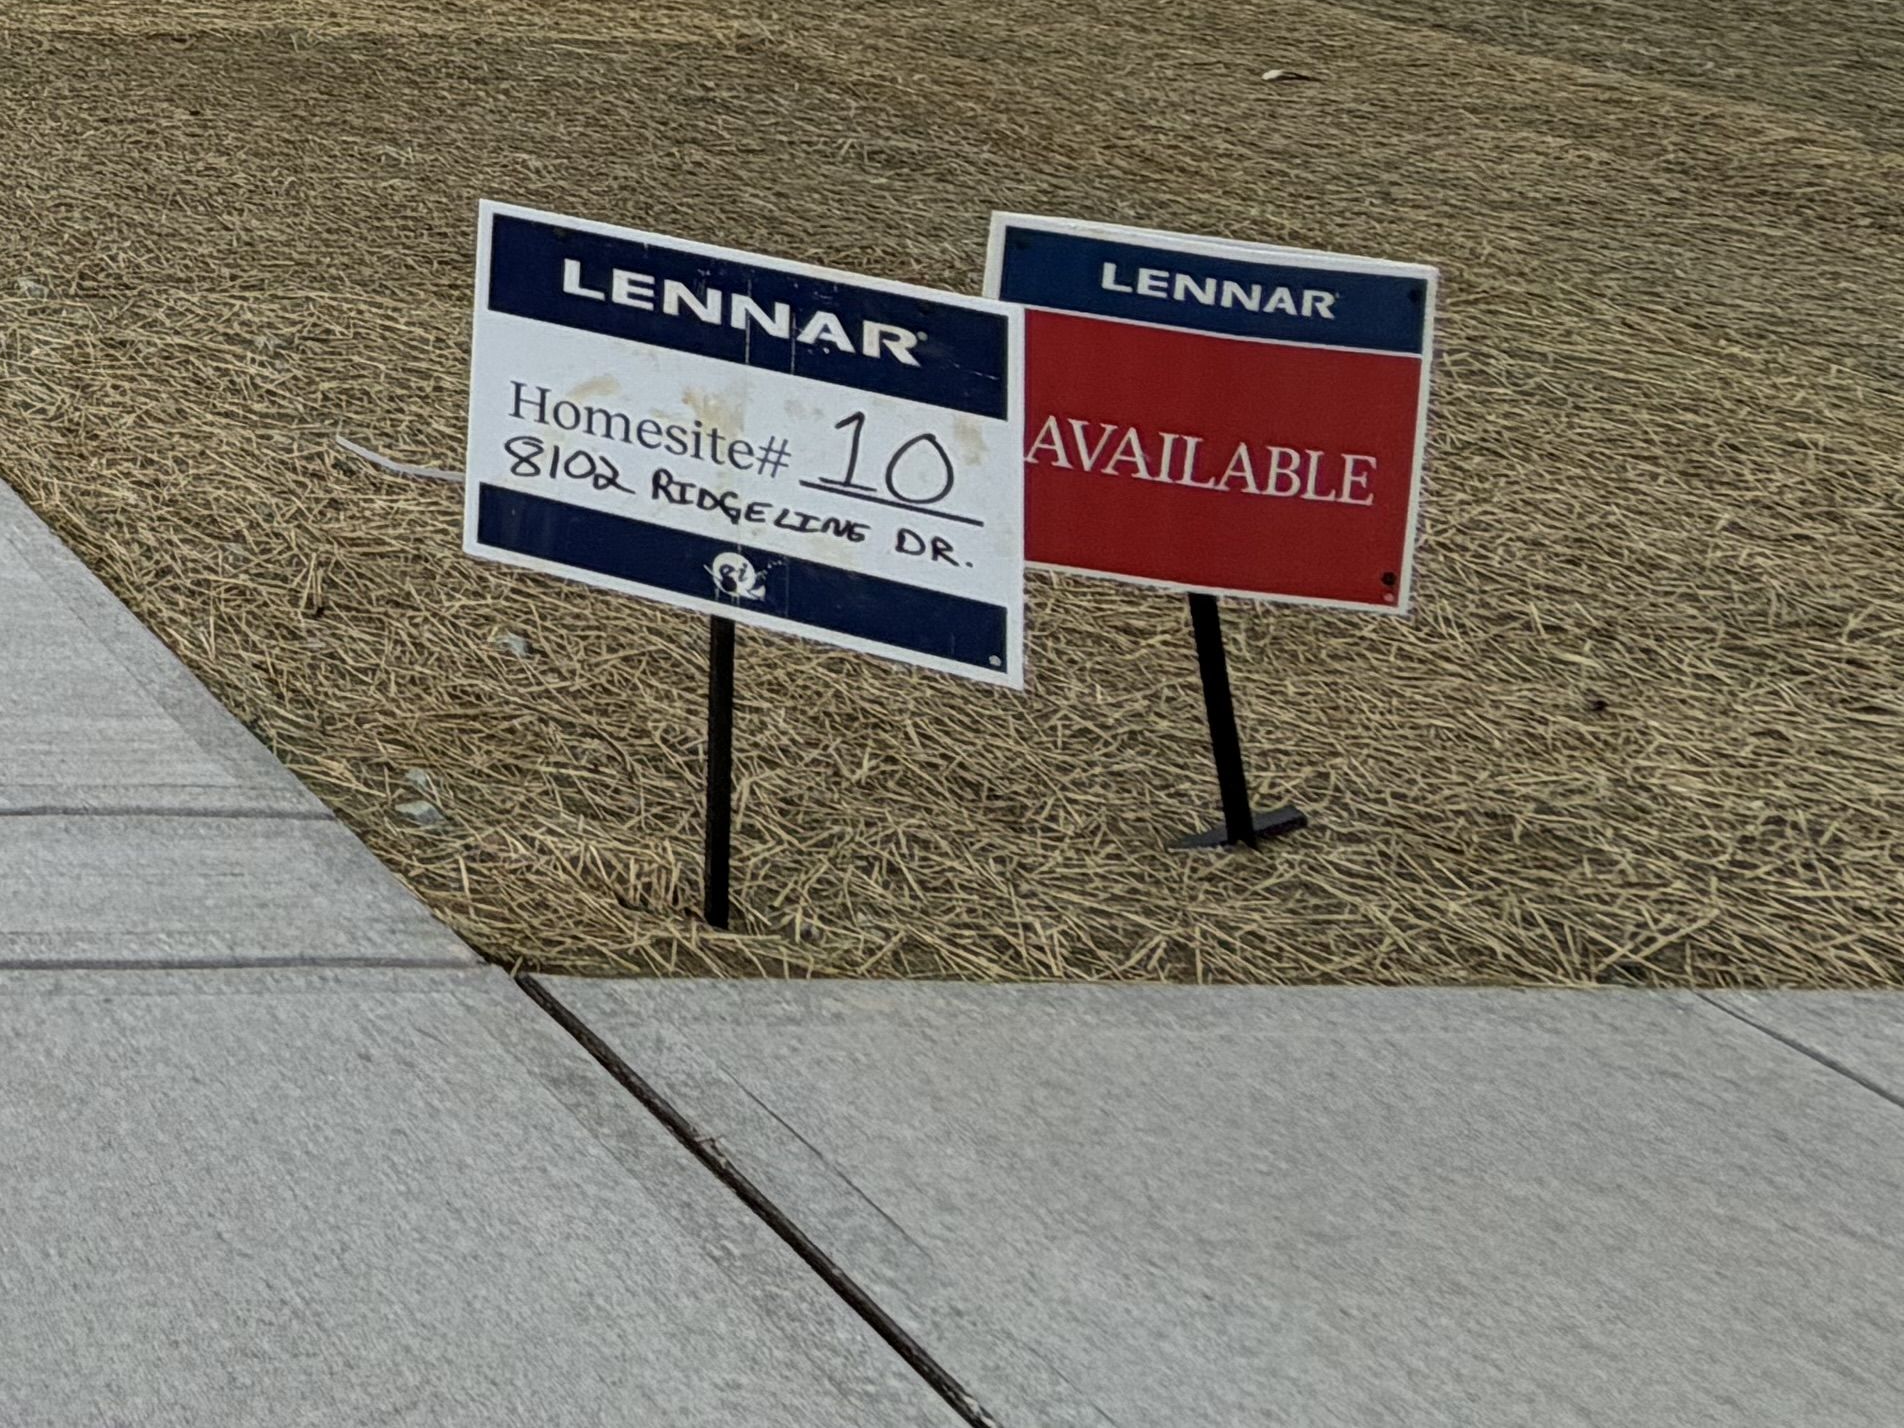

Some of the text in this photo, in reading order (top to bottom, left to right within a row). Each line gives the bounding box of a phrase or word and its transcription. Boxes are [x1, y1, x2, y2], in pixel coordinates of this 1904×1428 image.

[561, 257, 923, 368] LENNAR
[1100, 261, 1337, 320] LENNAR
[504, 436, 636, 495] 8102
[895, 527, 974, 568] DR.
[818, 410, 955, 506] 10
[1024, 414, 1378, 507] AVAILABLE
